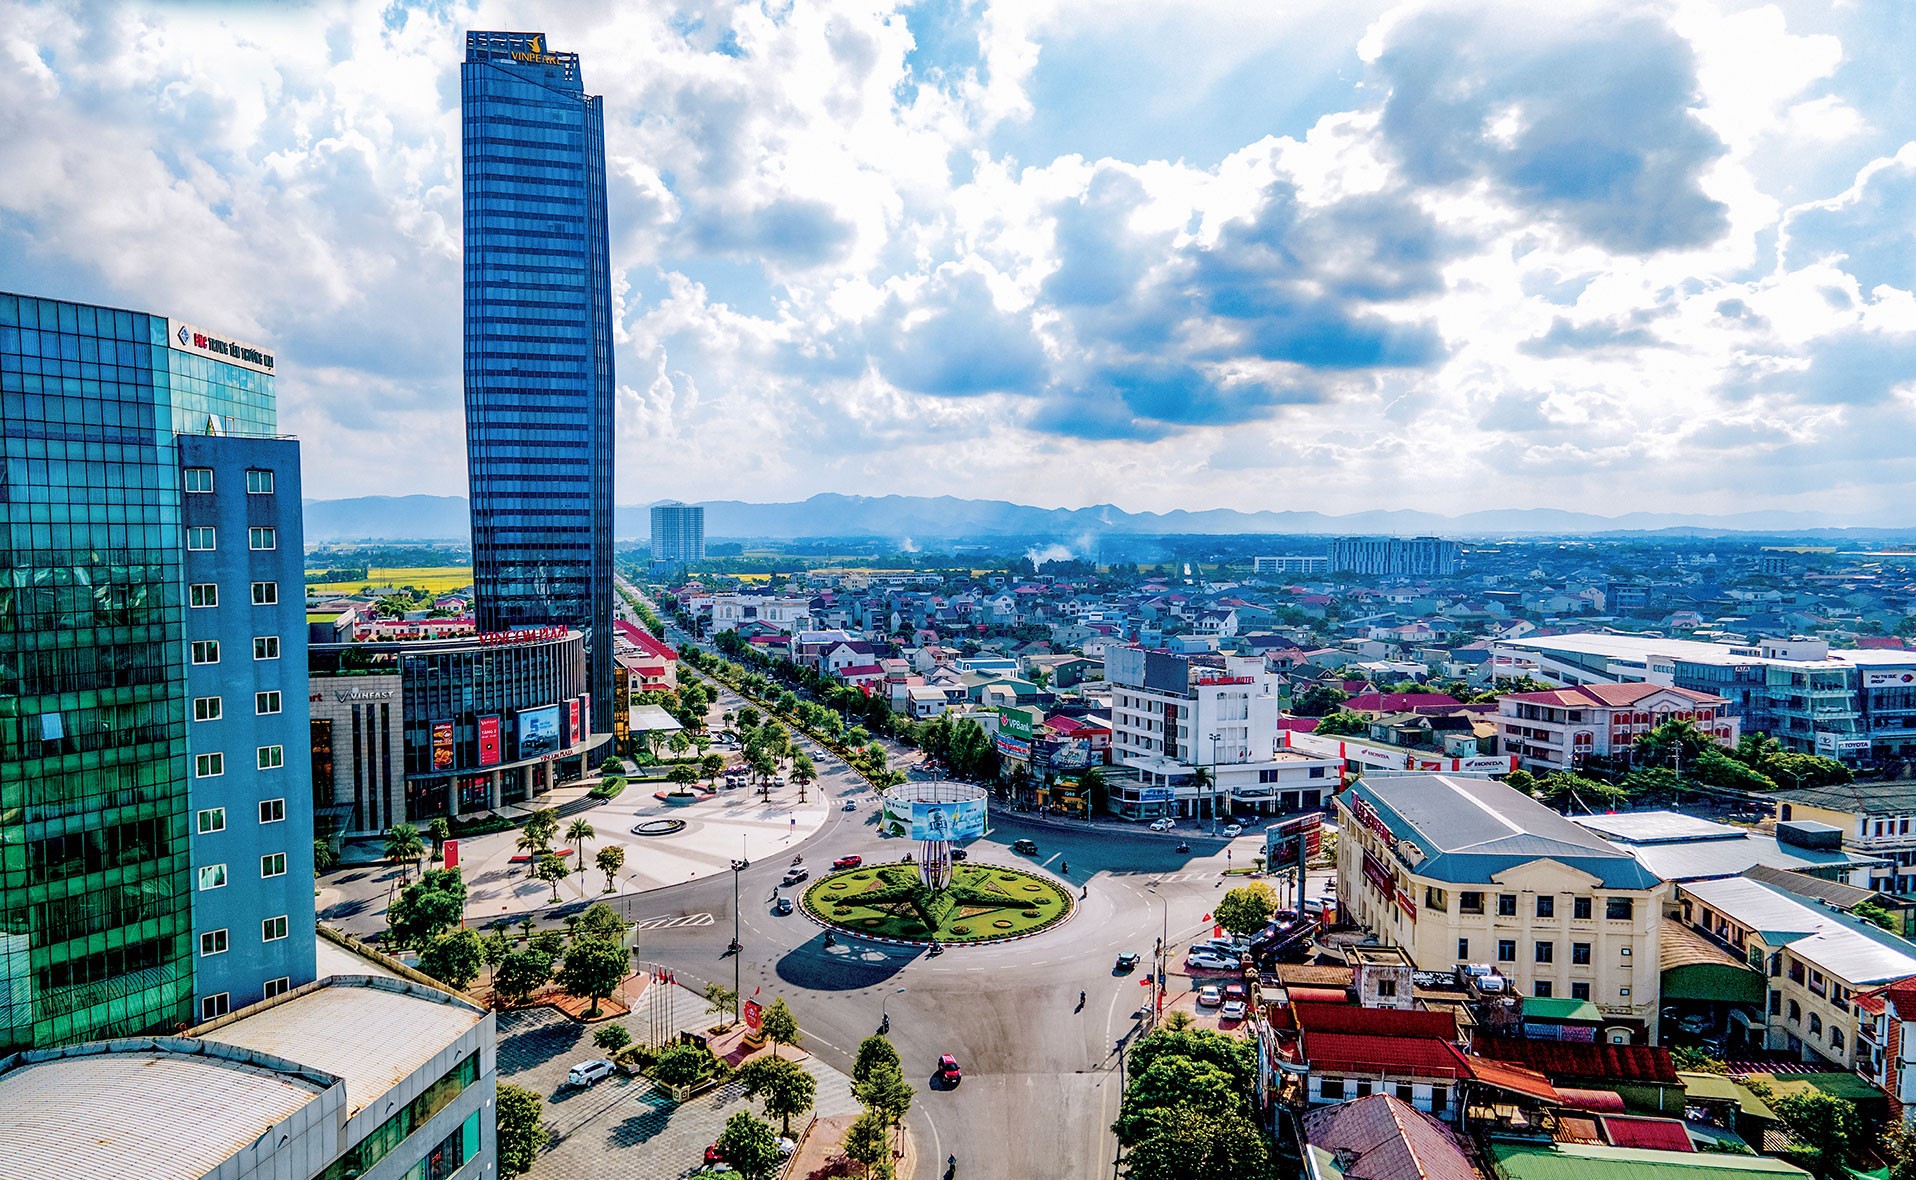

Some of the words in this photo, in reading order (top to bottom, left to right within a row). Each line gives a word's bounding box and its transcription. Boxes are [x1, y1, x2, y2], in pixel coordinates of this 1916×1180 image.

[511, 51, 562, 66] VINPEARL
[477, 629, 537, 646] VINCOM
[538, 624, 569, 640] PLAZA
[350, 690, 394, 700] VINFAST
[1008, 718, 1031, 732] VPBank
[560, 750, 573, 758] PLAZA
[1368, 750, 1390, 760] HONDA
